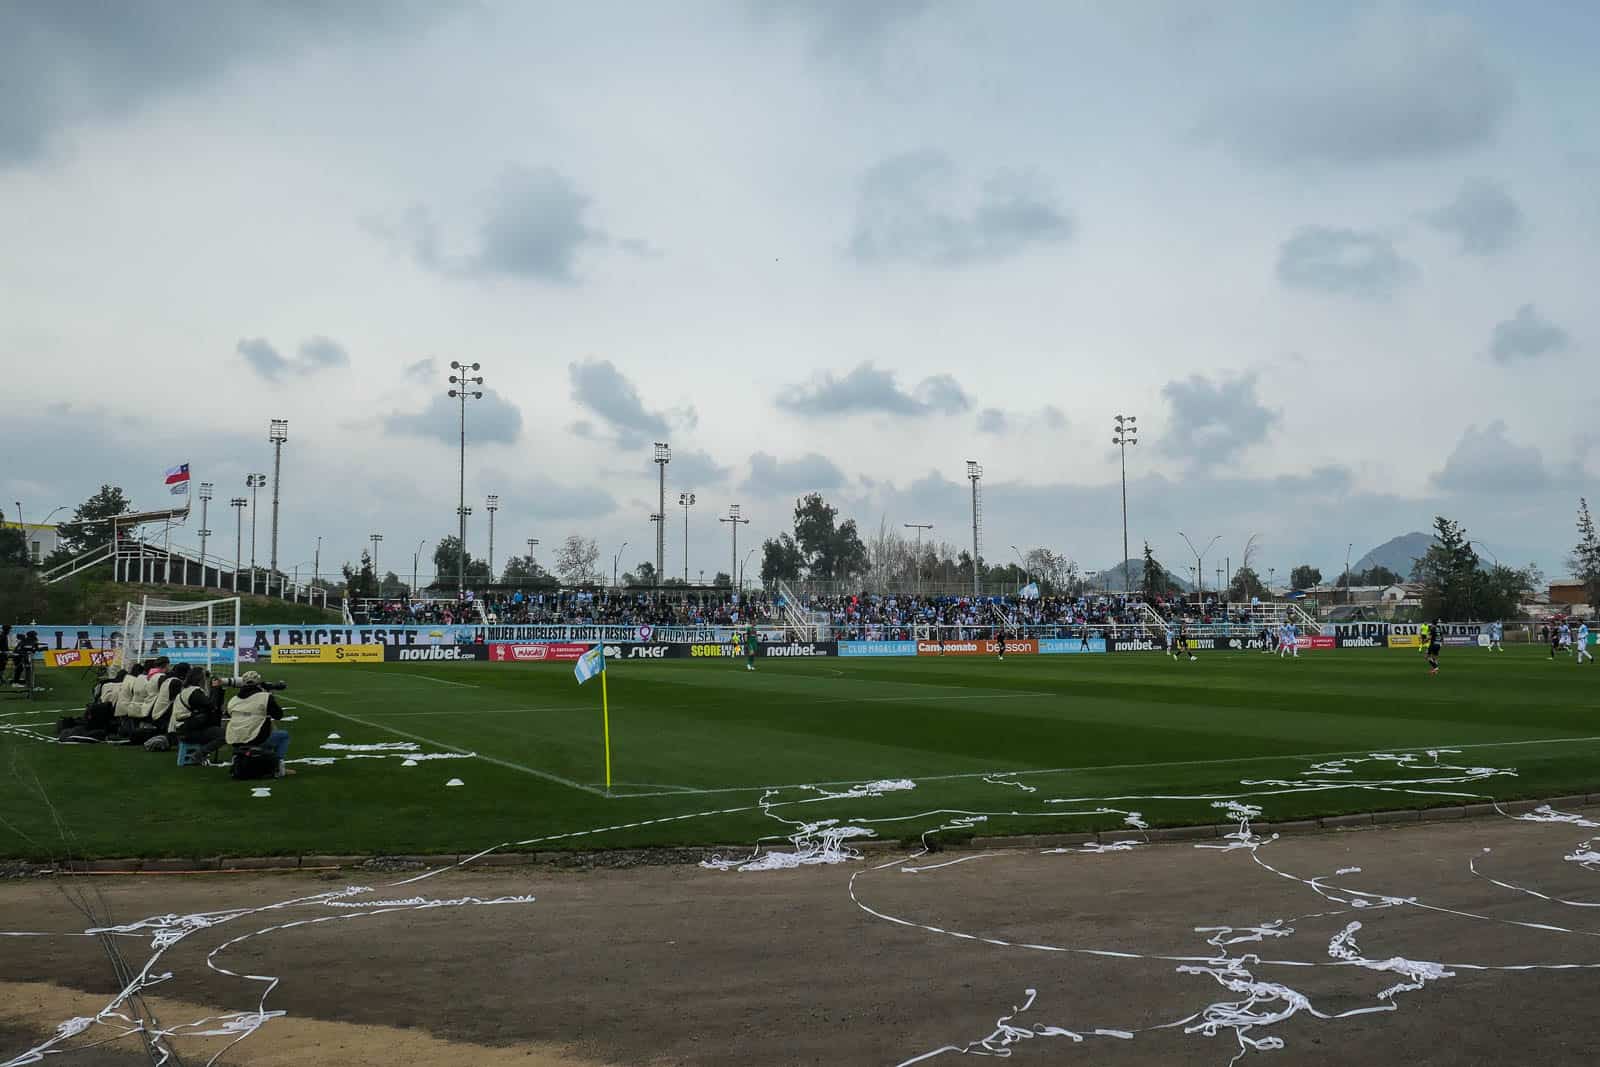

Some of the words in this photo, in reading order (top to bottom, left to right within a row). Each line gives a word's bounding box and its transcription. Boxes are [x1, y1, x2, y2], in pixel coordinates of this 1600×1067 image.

[488, 626, 515, 640] MUJER
[517, 626, 567, 640] ALBICELESTE
[570, 626, 597, 640] EXISTE
[598, 626, 604, 640] Y
[605, 627, 637, 640] RESISTE
[55, 631, 93, 649] LA
[254, 629, 418, 650] ALBICELESTE
[691, 645, 722, 656] SCORE
[986, 641, 1031, 652] besson
